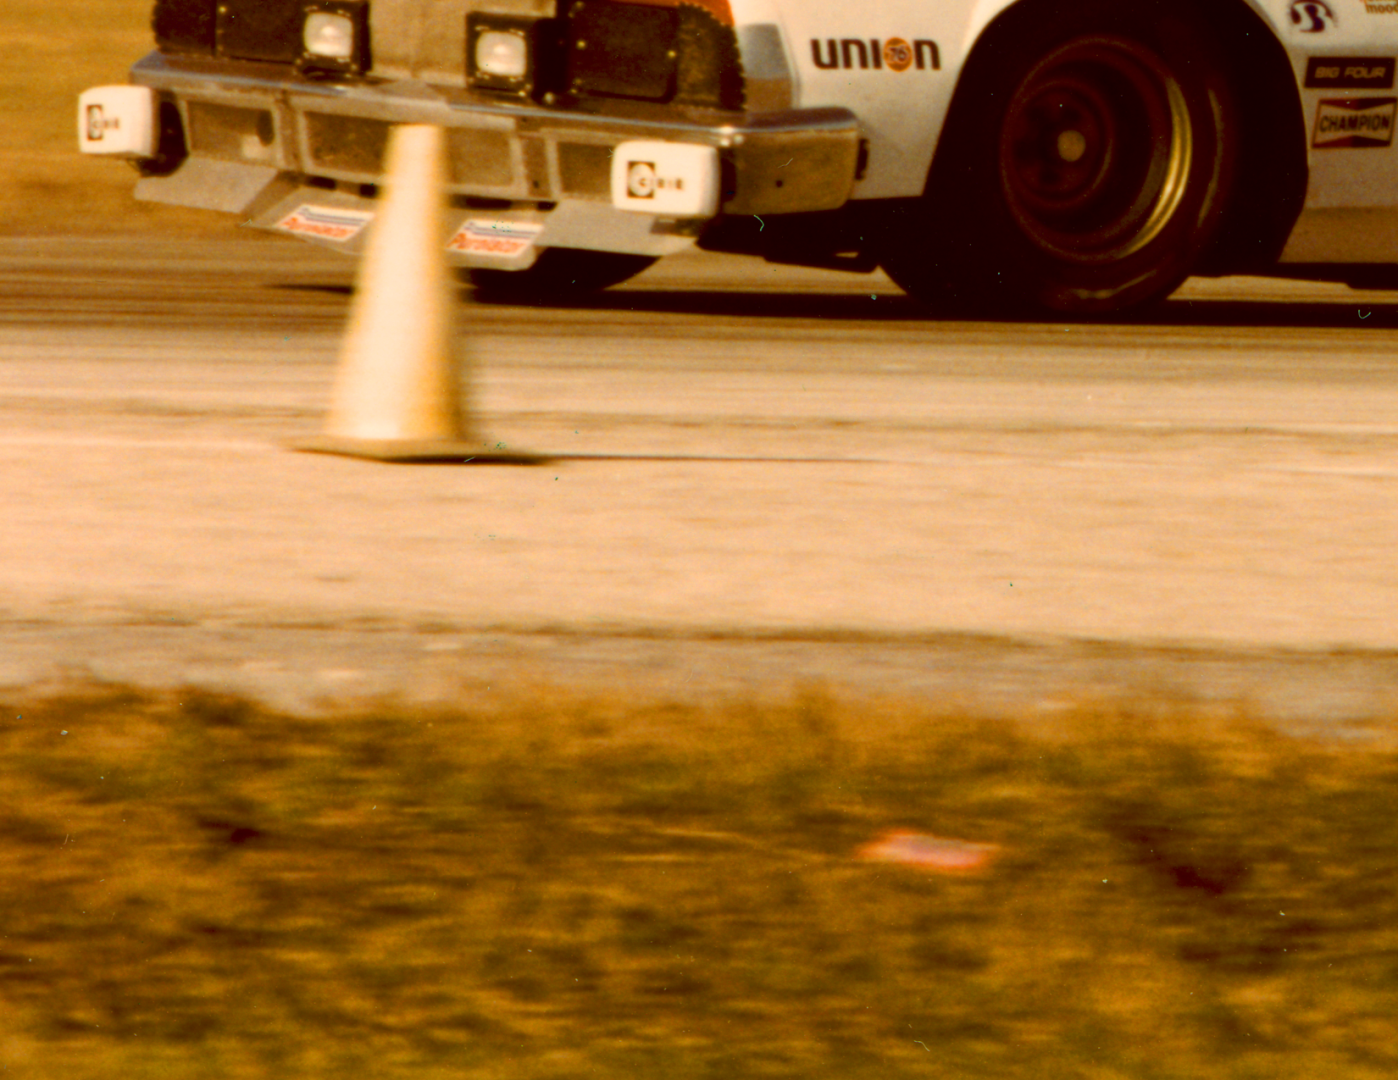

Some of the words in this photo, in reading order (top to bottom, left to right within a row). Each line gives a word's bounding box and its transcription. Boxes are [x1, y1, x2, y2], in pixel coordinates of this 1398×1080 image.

[1314, 66, 1340, 79] BIG
[1344, 66, 1386, 79] FOUR
[1319, 114, 1391, 132] CHAMPION
